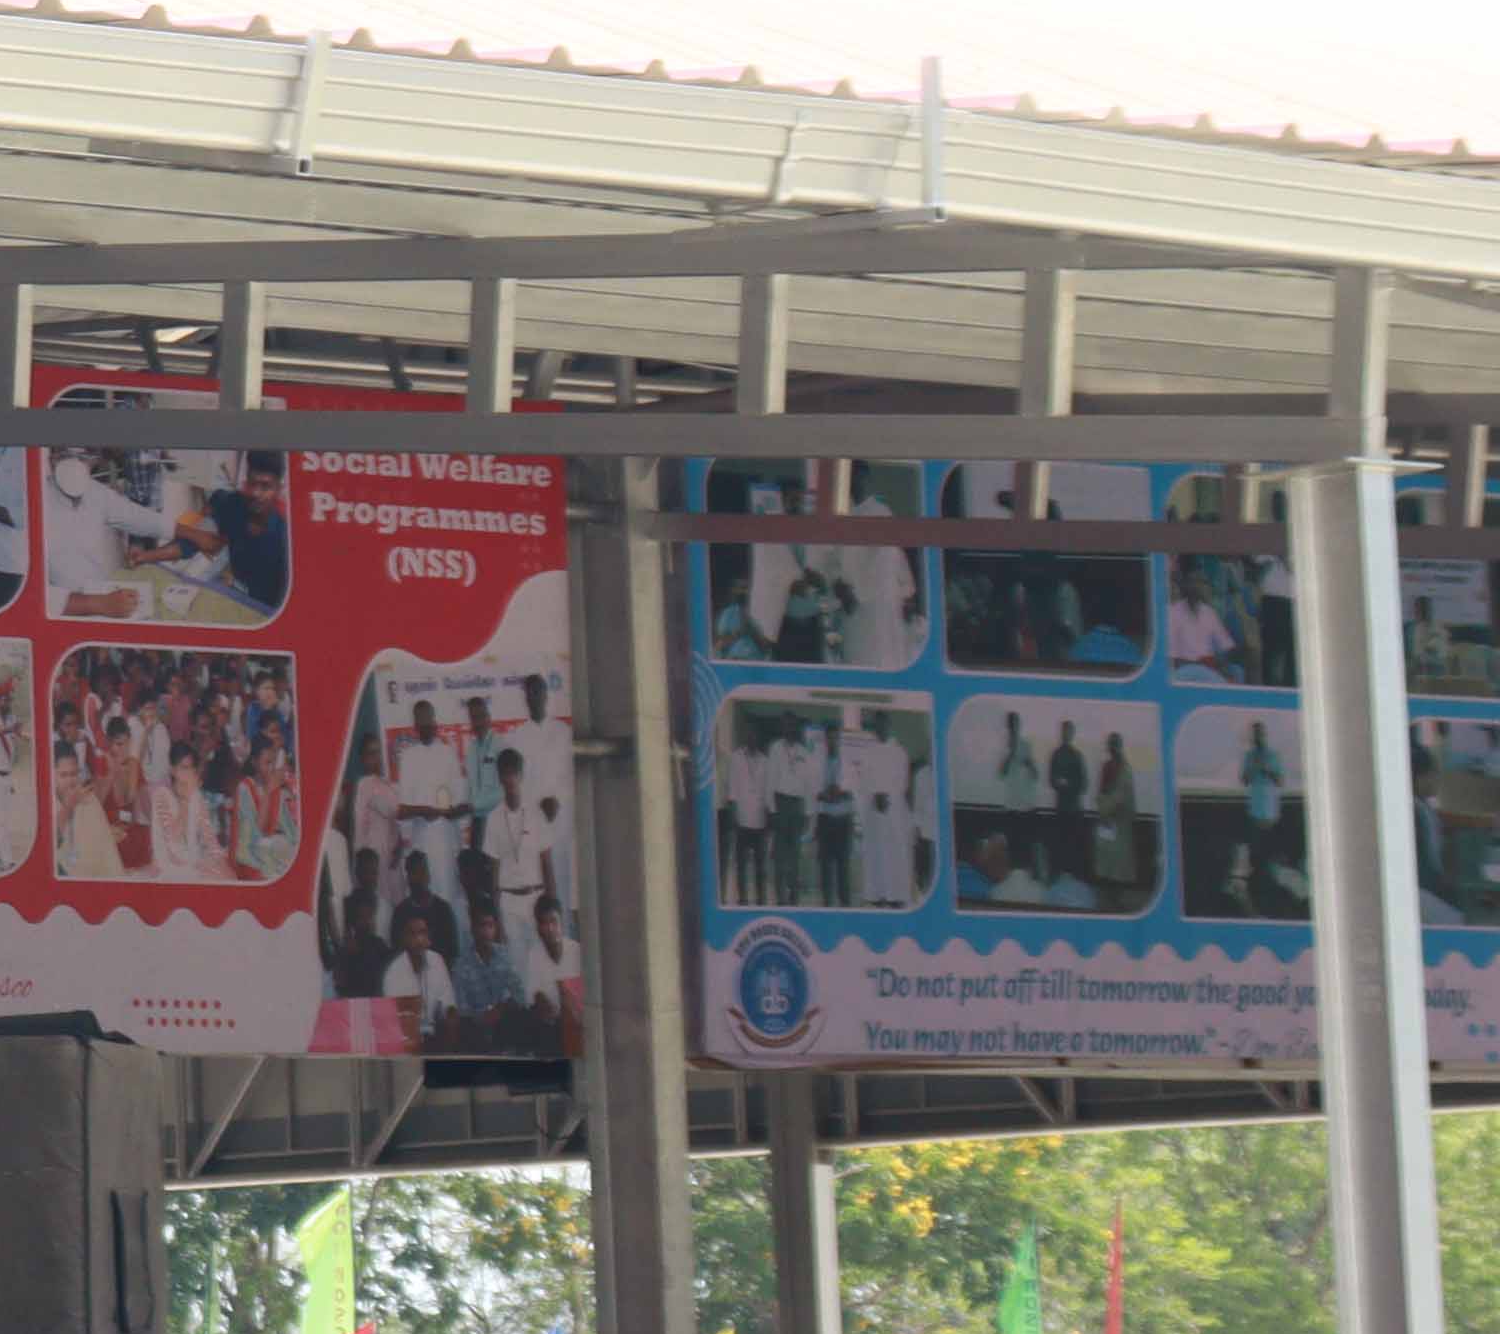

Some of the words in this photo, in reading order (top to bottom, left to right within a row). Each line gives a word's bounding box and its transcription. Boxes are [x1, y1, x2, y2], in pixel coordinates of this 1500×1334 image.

[416, 452, 553, 488] Welfare
[309, 490, 548, 536] Programmes
[386, 545, 477, 588] (NSS)
[916, 972, 957, 1000] not
[960, 972, 999, 1006] put
[1003, 968, 1038, 1004] off
[1039, 969, 1072, 1001] till
[1076, 972, 1191, 1005] tomorrow
[1195, 974, 1232, 1003] the
[1236, 977, 1290, 1012] good
[864, 1020, 907, 1053] You
[913, 1030, 963, 1058] may
[969, 1028, 1008, 1052] not
[1013, 1026, 1067, 1053] have
[1069, 1032, 1084, 1053] a
